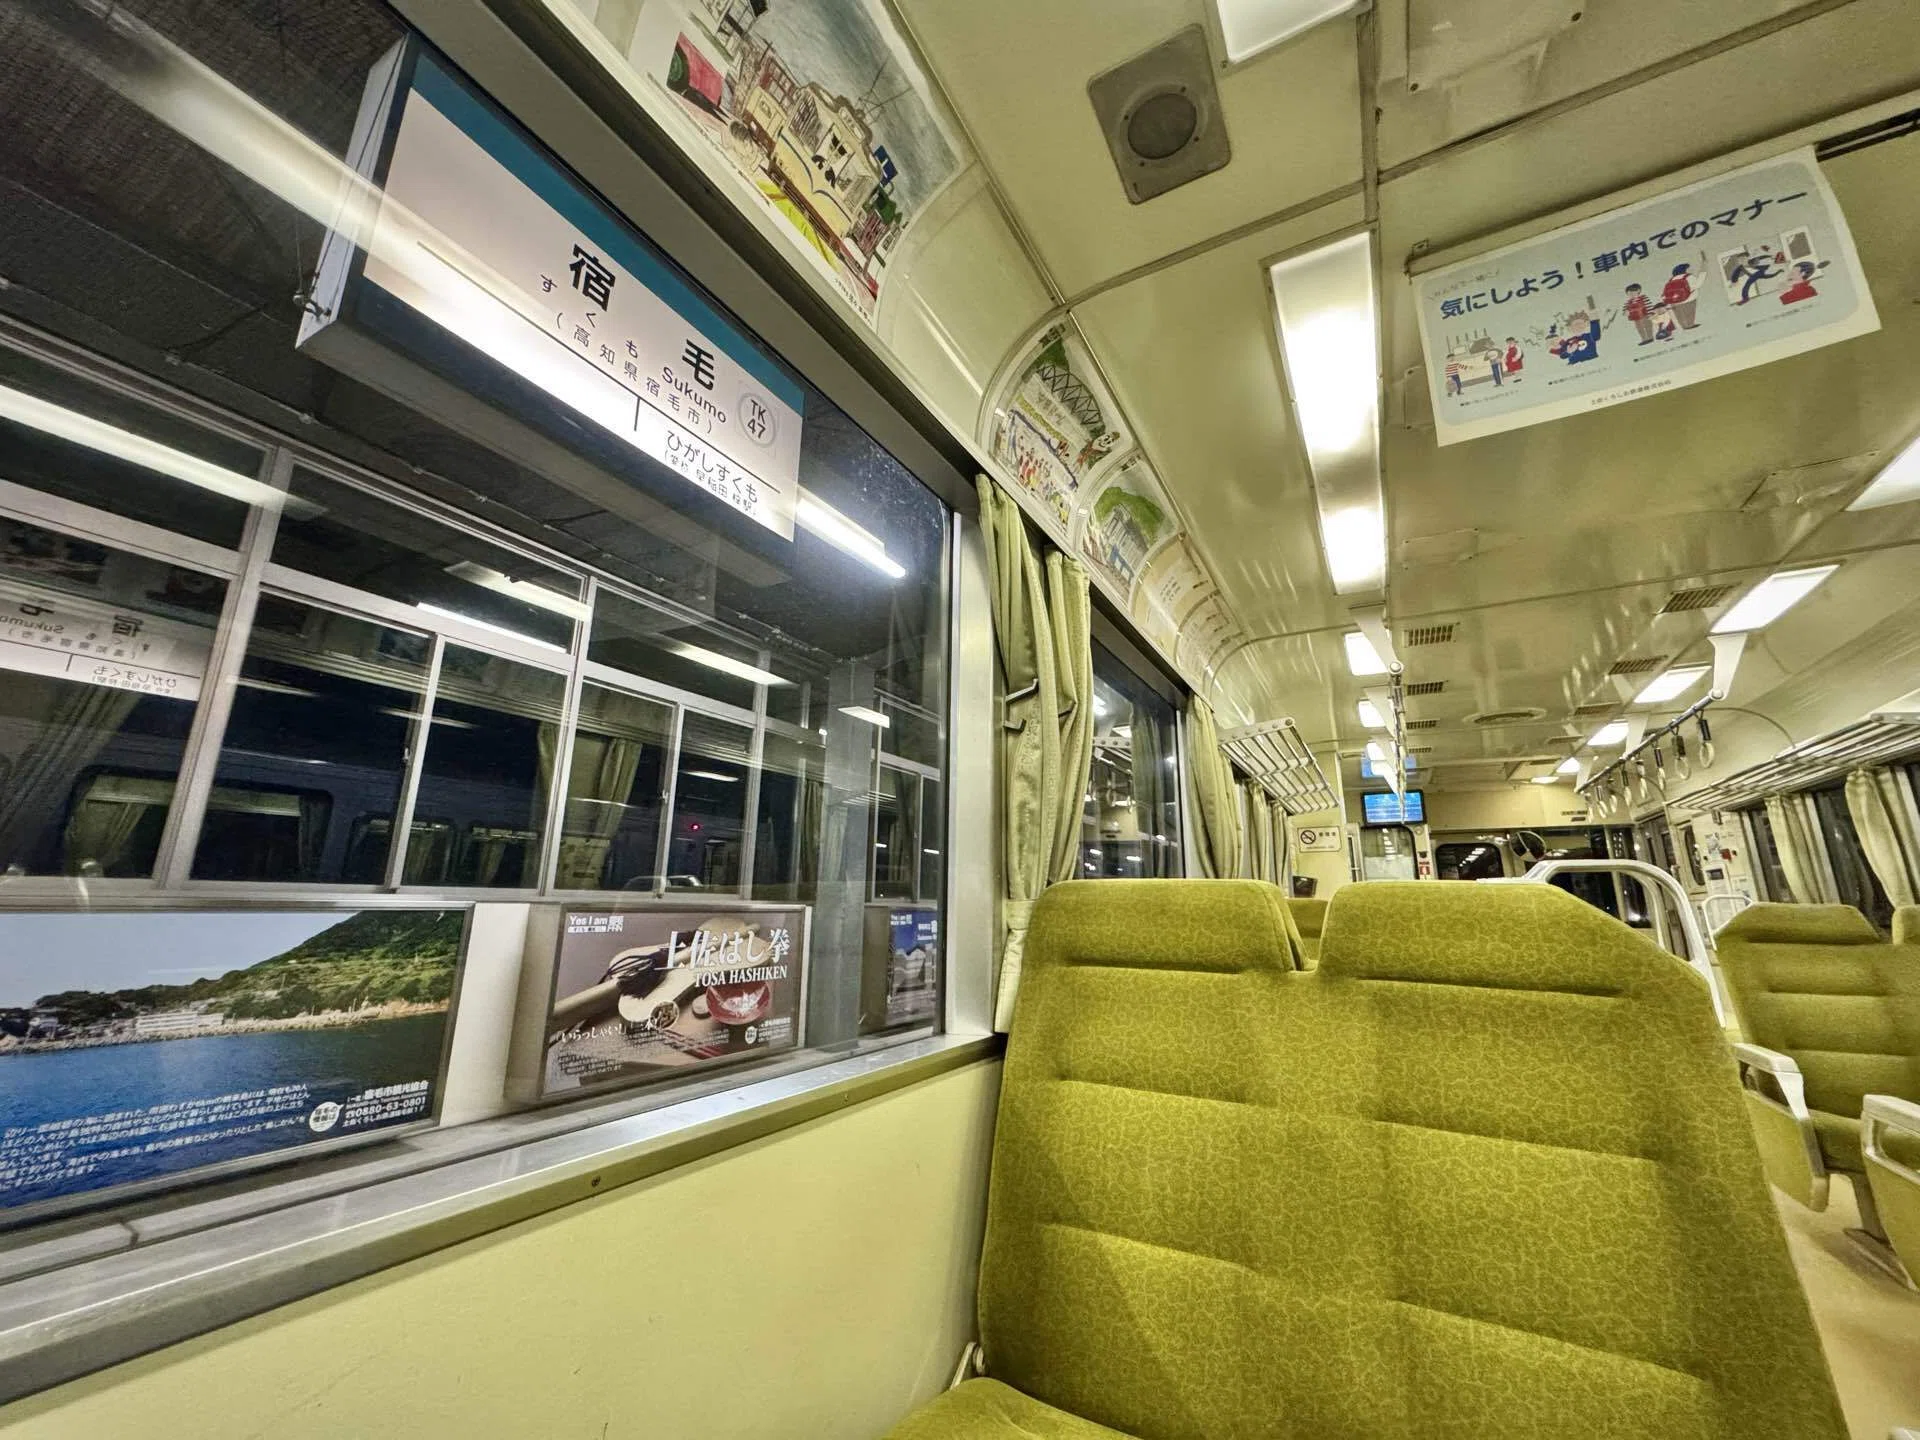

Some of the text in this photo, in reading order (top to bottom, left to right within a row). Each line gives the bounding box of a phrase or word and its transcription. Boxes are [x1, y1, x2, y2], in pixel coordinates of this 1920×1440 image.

[541, 274, 727, 423] すくも Sukumo
[569, 244, 715, 391] 宿毛
[556, 312, 713, 434] （高知県宿毛市）
[747, 419, 766, 440] 47
[750, 399, 767, 423] TK
[666, 430, 757, 503] ひがしすくも
[694, 965, 788, 988] TOSA HASHIKEN
